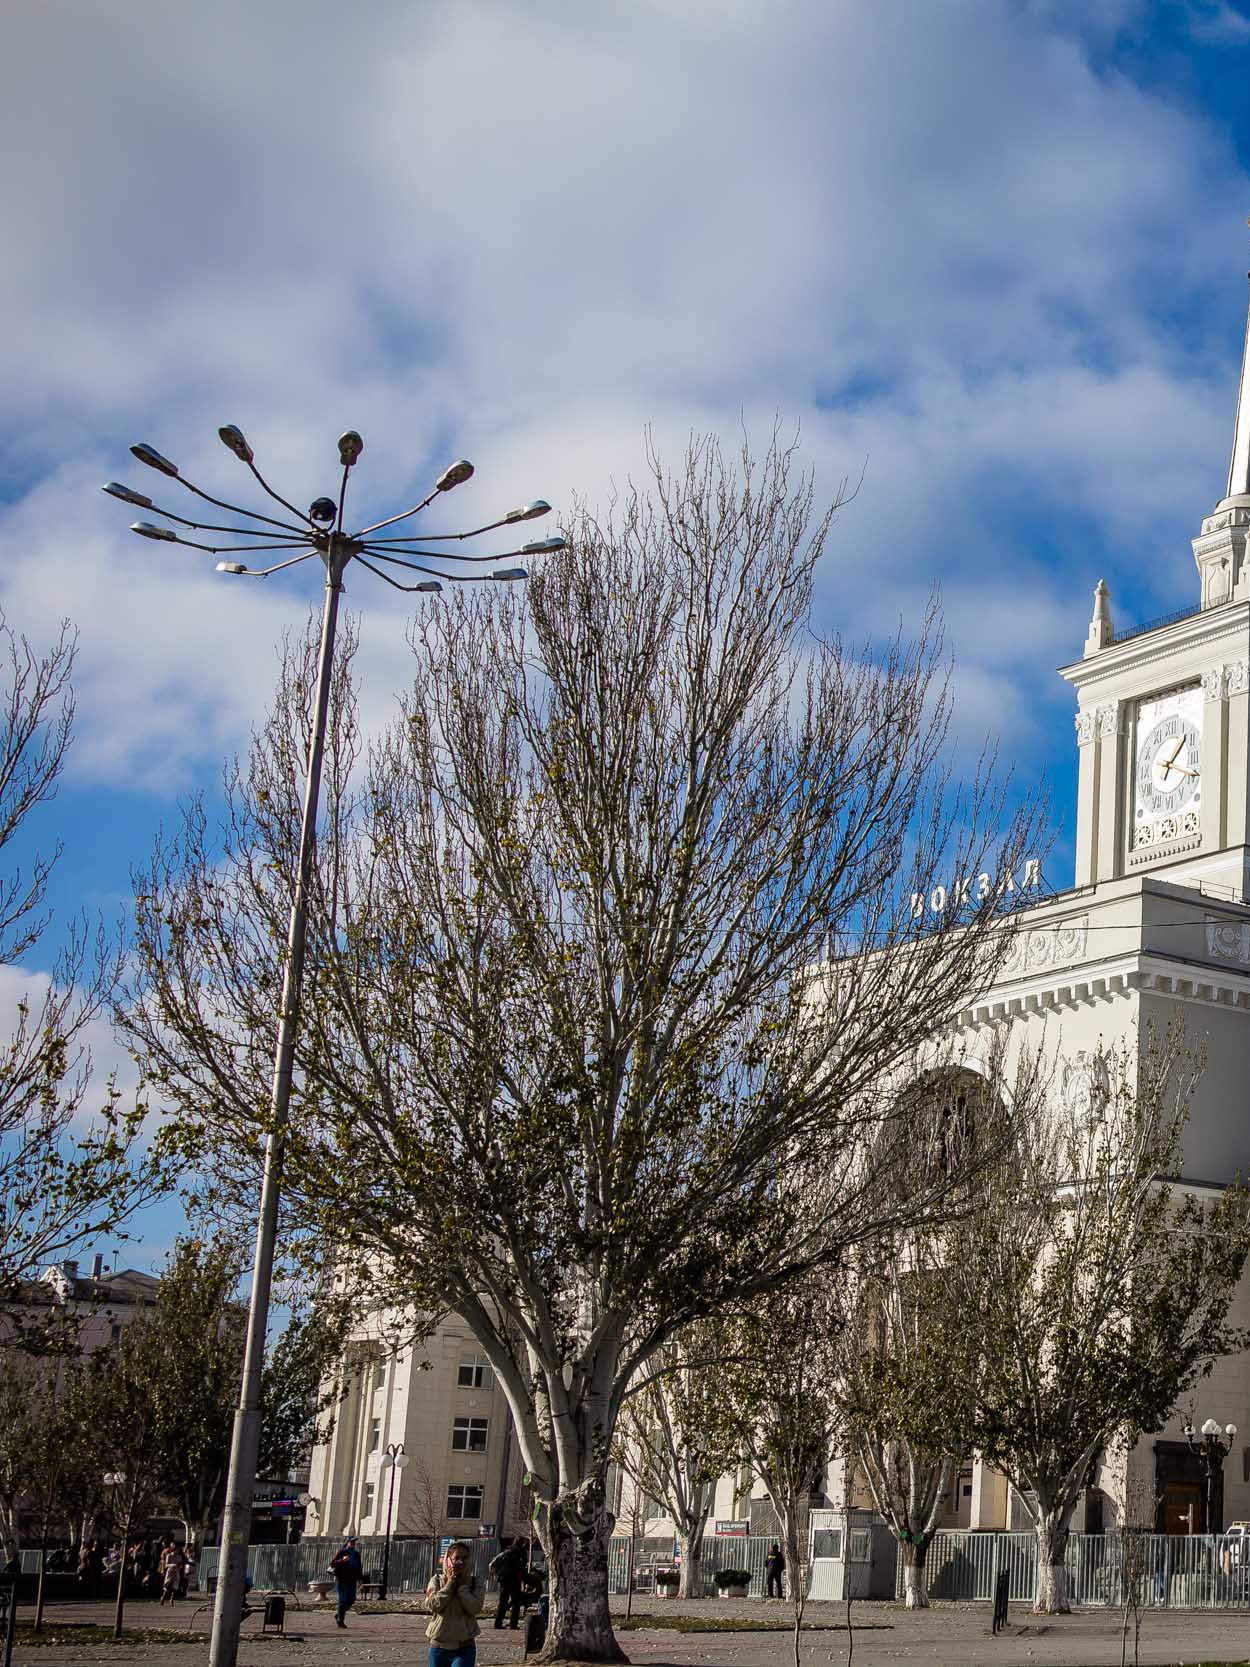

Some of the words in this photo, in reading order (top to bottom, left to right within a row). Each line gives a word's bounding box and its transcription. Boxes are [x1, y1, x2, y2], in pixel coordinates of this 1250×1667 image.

[1166, 719, 1176, 737] XII
[1153, 728, 1161, 745] XI
[1189, 733, 1195, 746] II
[1145, 746, 1150, 760] X
[1190, 750, 1198, 765] III
[1141, 764, 1149, 780] IX
[1179, 786, 1184, 800] V
[1153, 795, 1161, 809] VII
[1166, 795, 1173, 809] VI
